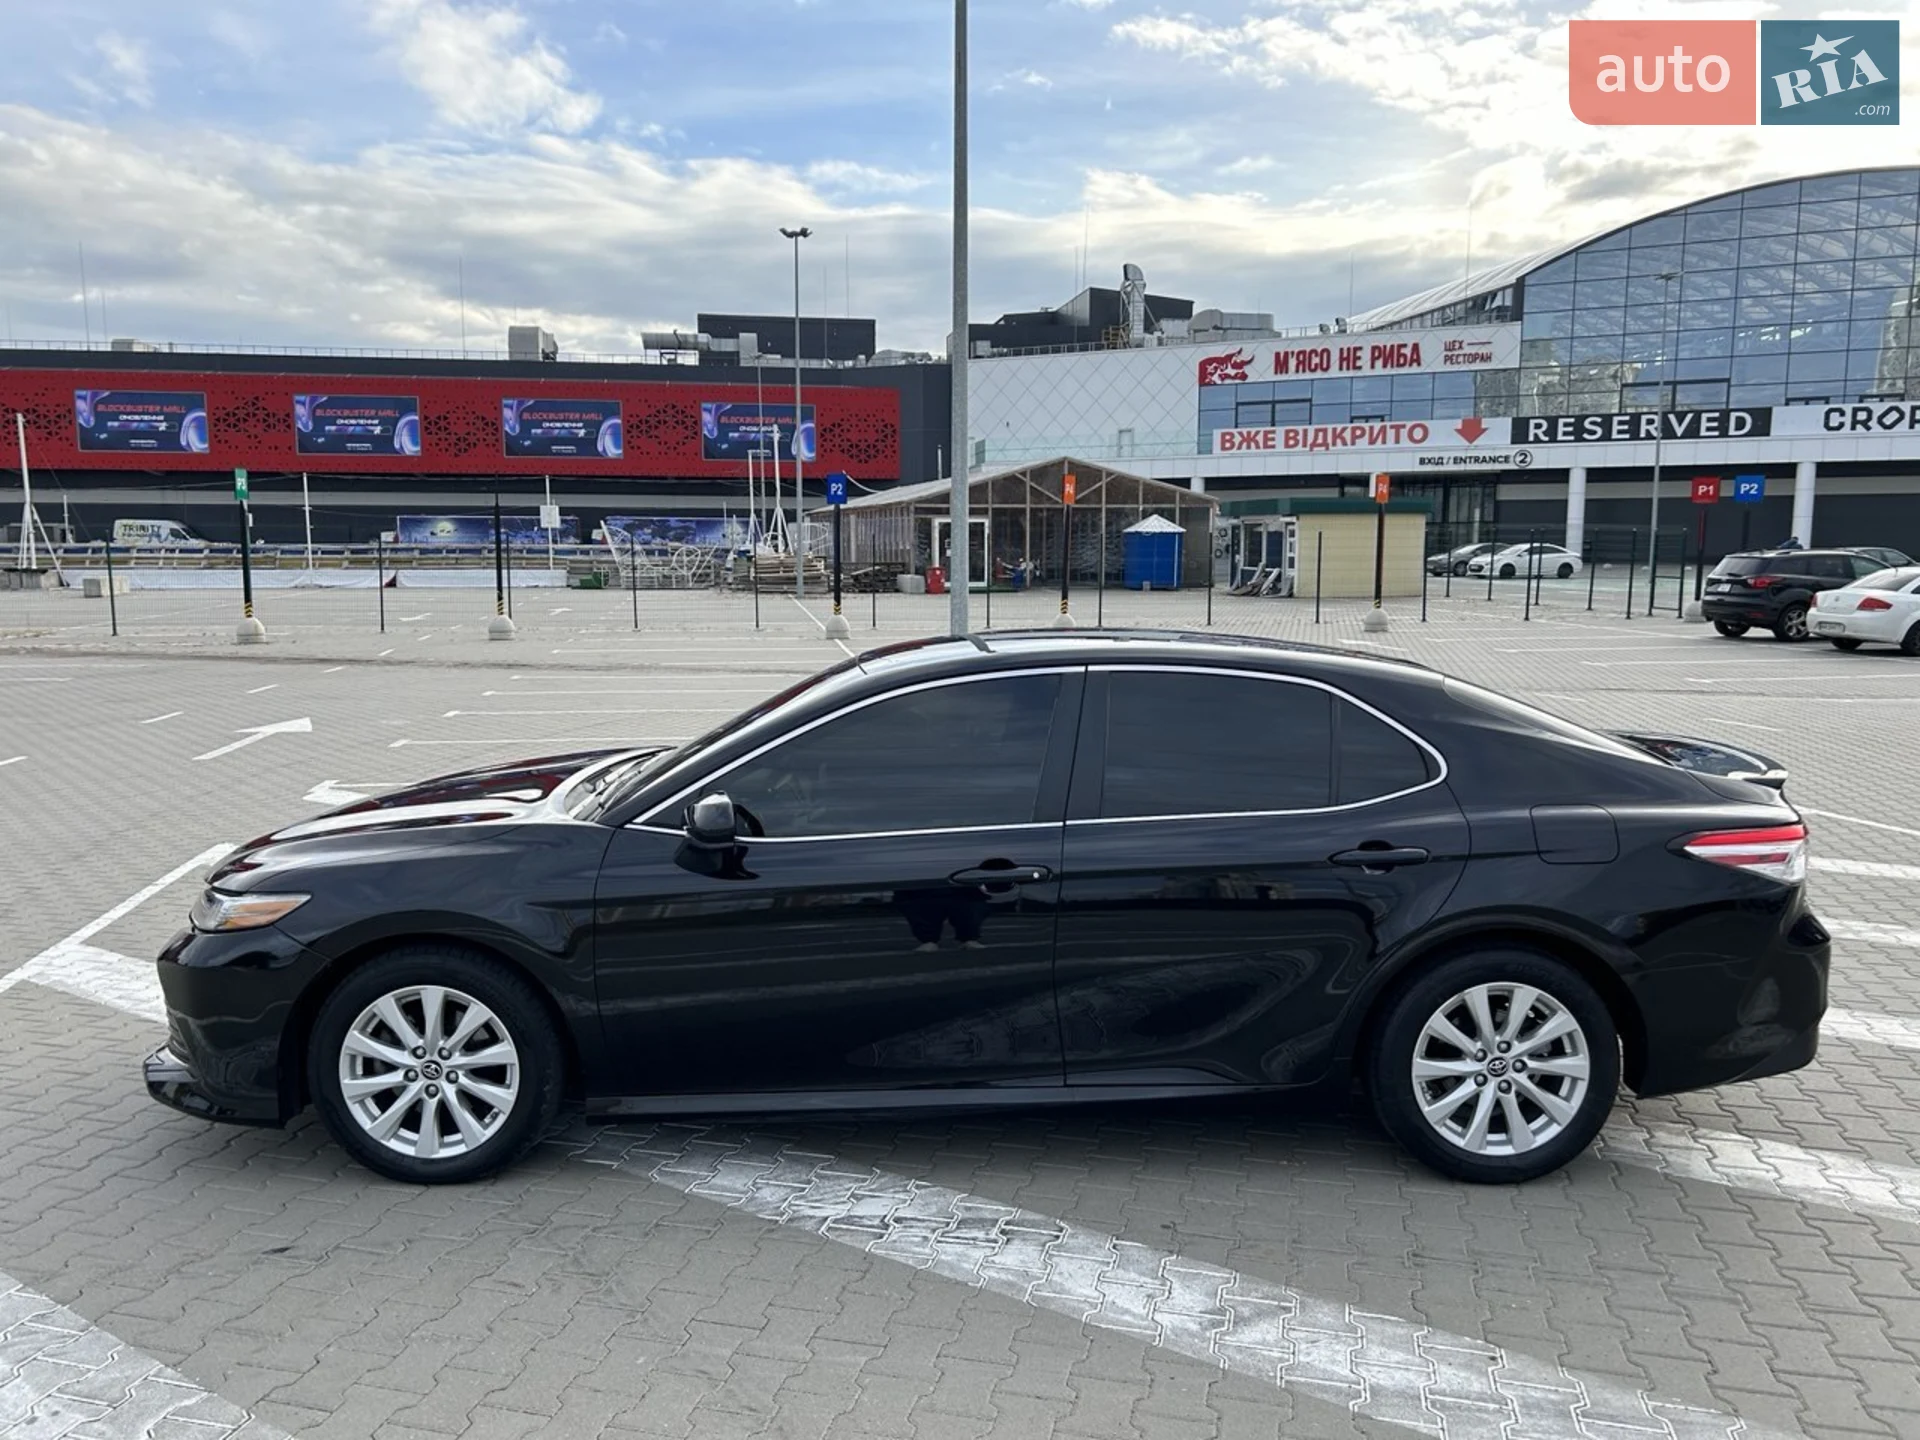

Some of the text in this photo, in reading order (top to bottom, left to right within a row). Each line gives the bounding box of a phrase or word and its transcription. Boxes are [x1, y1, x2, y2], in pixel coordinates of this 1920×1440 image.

[1444, 340, 1465, 352] ЦЕХ
[1274, 342, 1422, 375] М'ЯСО НЕ РИБА
[1444, 352, 1493, 366] РЕСТОРАН
[96, 404, 187, 413] BLOCKBUSTER MALL
[315, 408, 400, 417] BLOCKBUSTER MALL
[522, 412, 580, 420] BLOCKBUSTER
[1528, 411, 1753, 442] RESERVED
[1220, 423, 1429, 451] ВЖЕ ВІДКРИТО
[1418, 456, 1444, 466] ВХІД
[1453, 454, 1511, 465] ENTRANCE
[830, 483, 843, 495] P2
[1697, 485, 1714, 495] P1
[1740, 483, 1758, 494] P2
